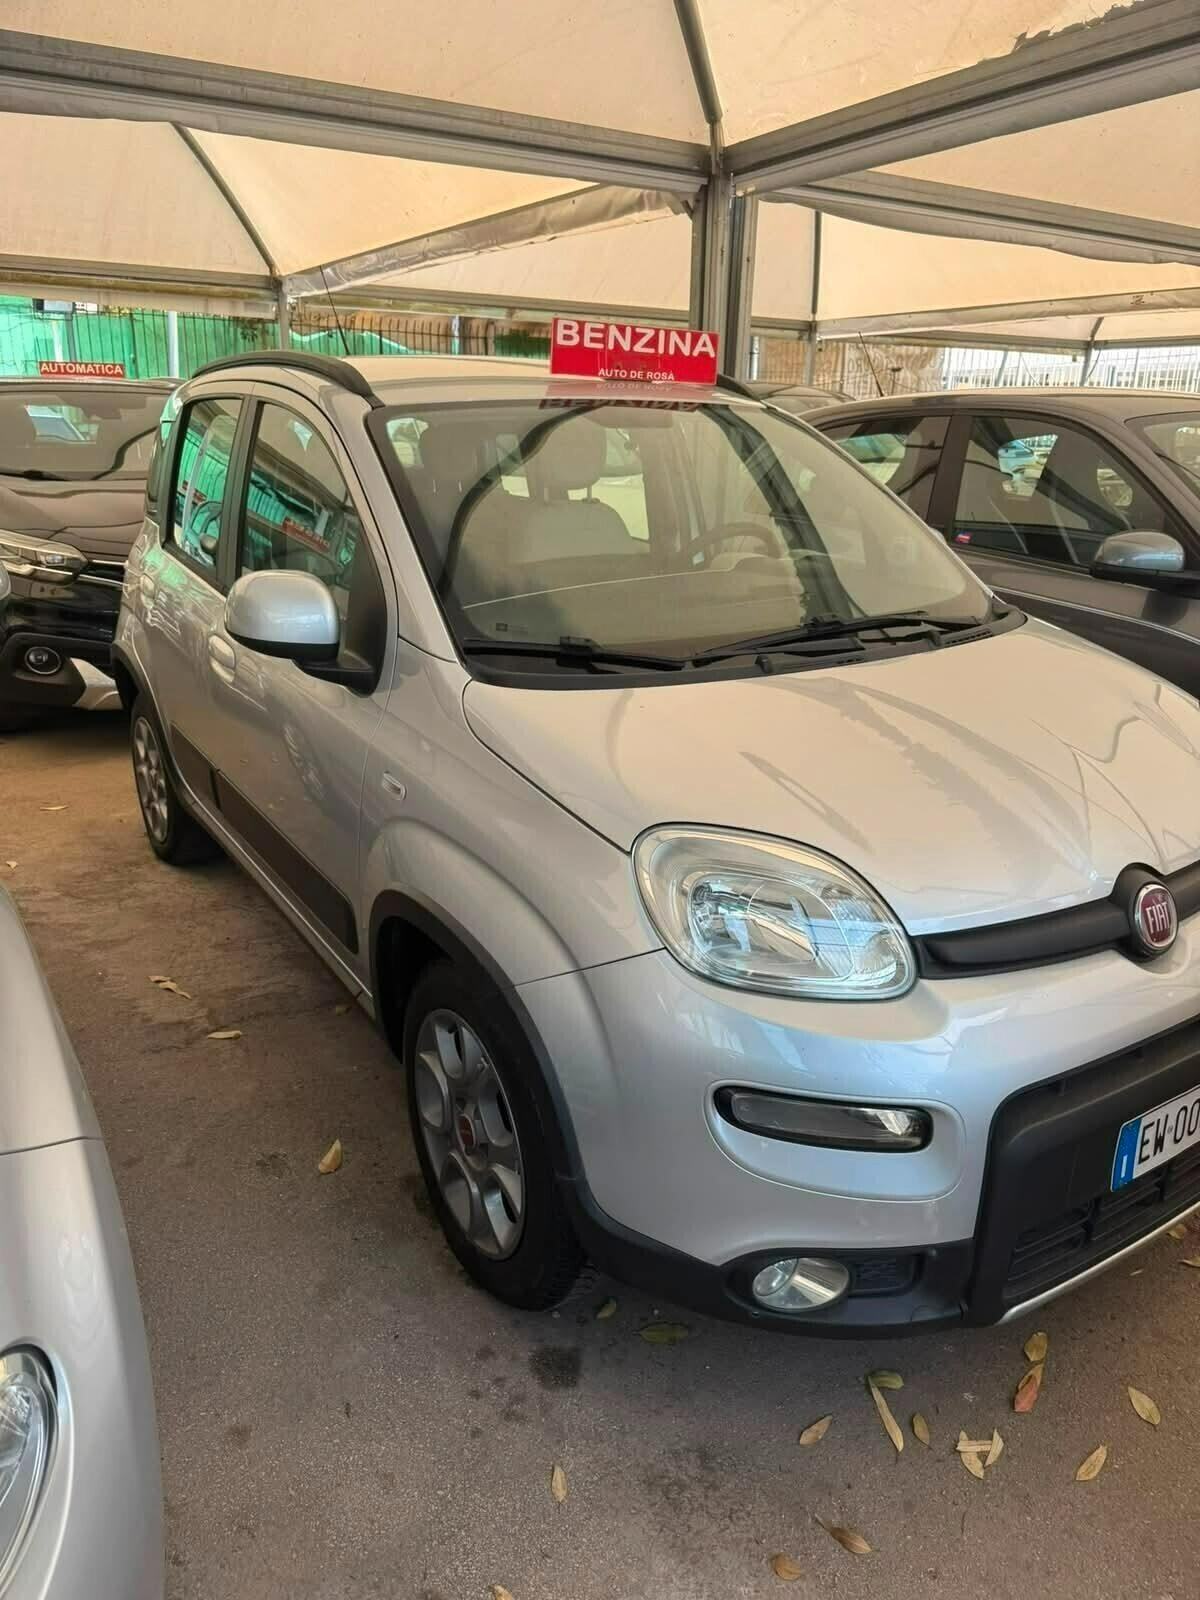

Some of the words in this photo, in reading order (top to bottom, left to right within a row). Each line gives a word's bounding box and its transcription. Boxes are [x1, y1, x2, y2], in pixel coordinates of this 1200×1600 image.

[556, 319, 715, 358] BENZINA
[41, 363, 123, 375] AUTOMATICA
[598, 368, 627, 378] AUTO
[629, 370, 644, 380] DE
[646, 371, 675, 381] ROSA
[1145, 901, 1170, 934] FIAT
